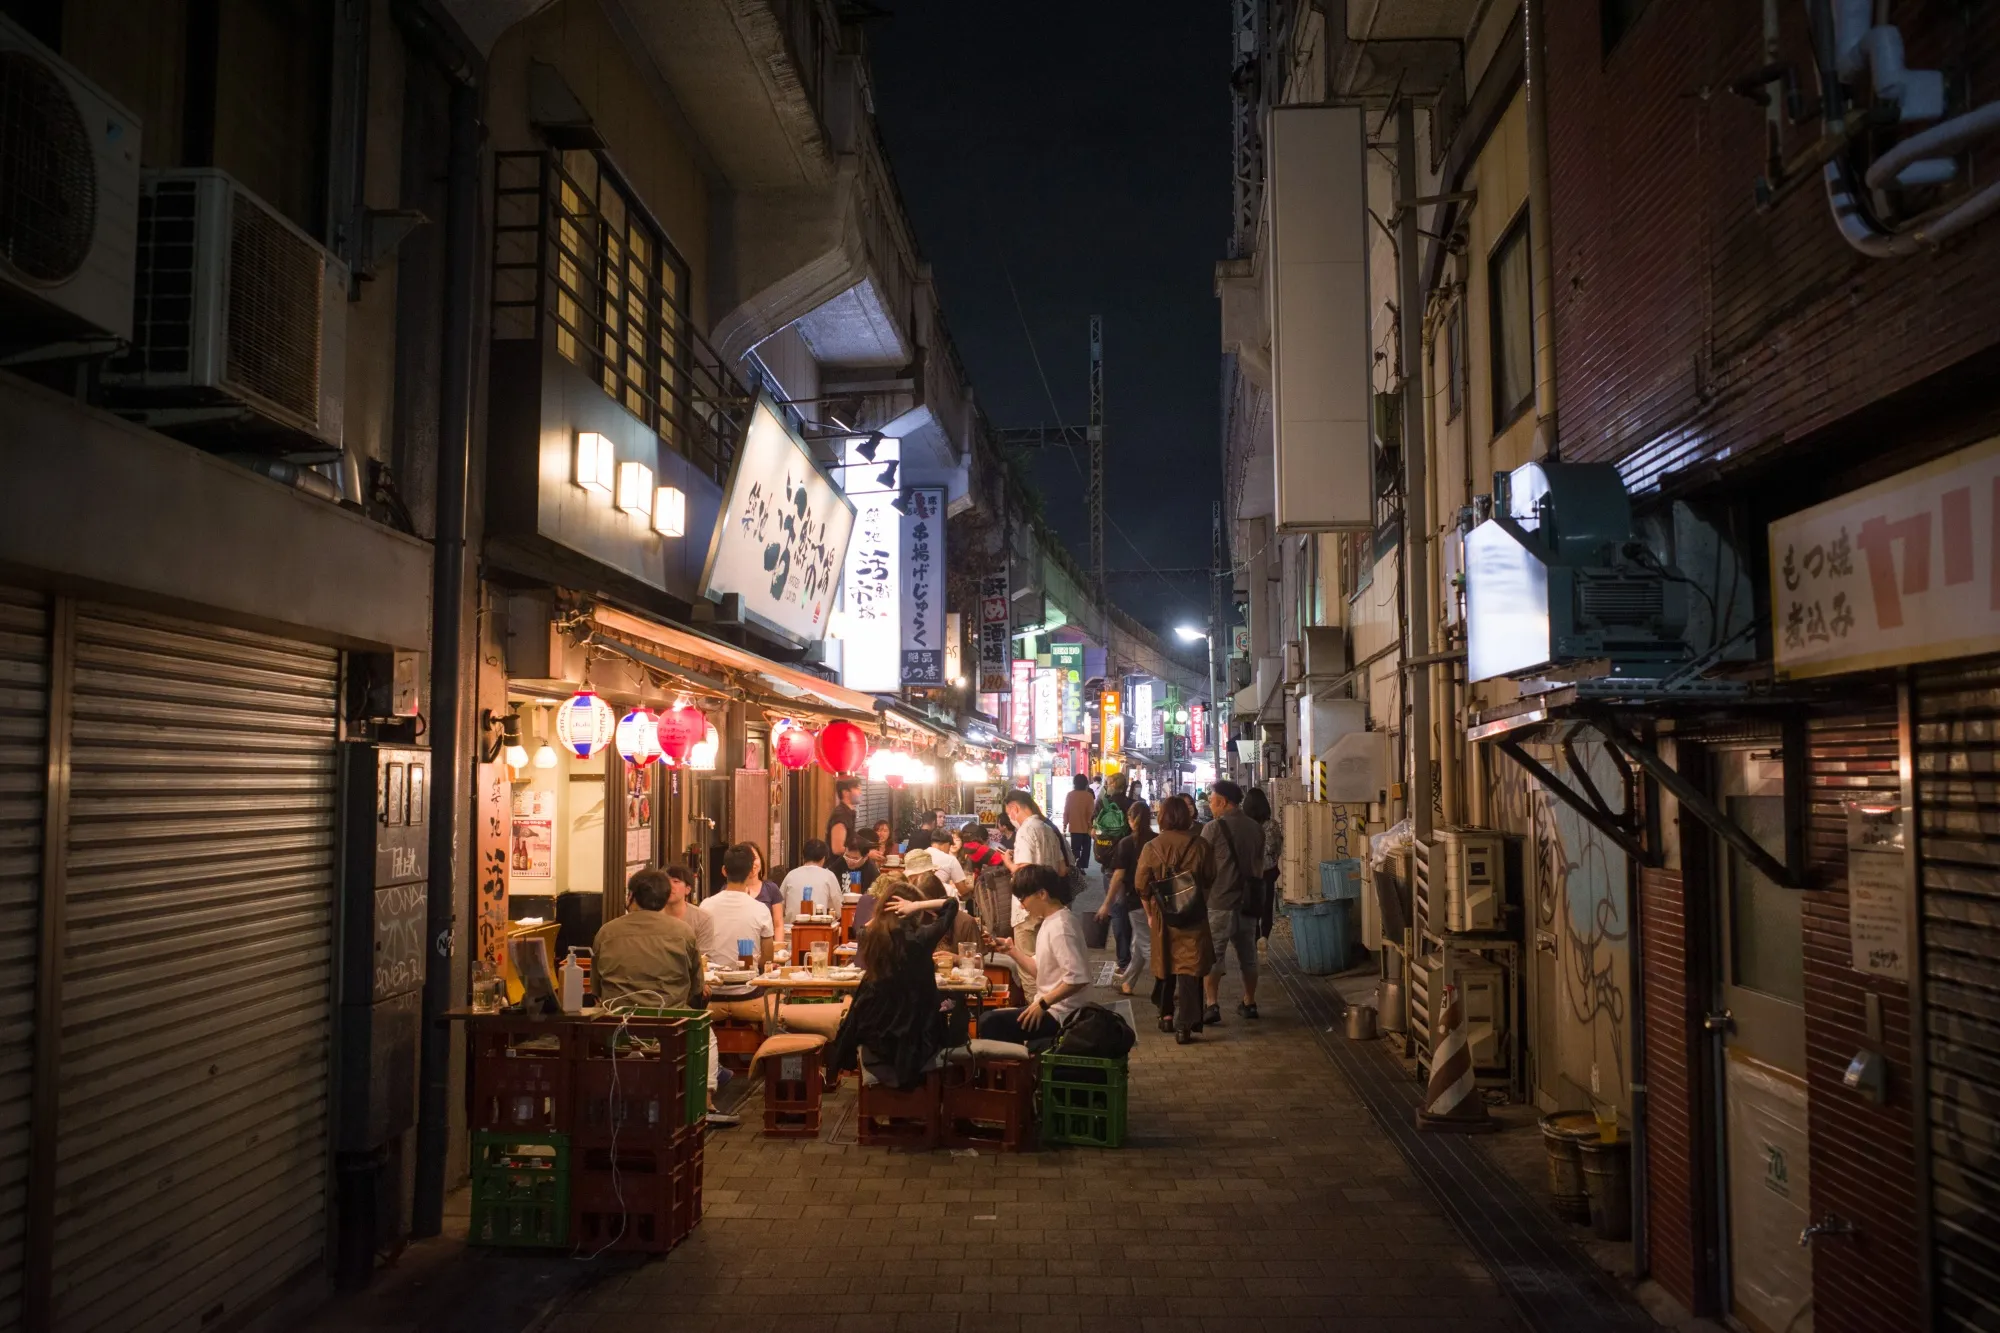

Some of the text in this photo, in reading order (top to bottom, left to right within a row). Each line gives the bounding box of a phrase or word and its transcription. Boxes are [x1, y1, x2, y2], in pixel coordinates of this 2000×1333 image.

[911, 522, 930, 648] 串揚げじゅらく
[1783, 525, 1854, 592] もつ焼
[1784, 591, 1855, 650] 煮込み
